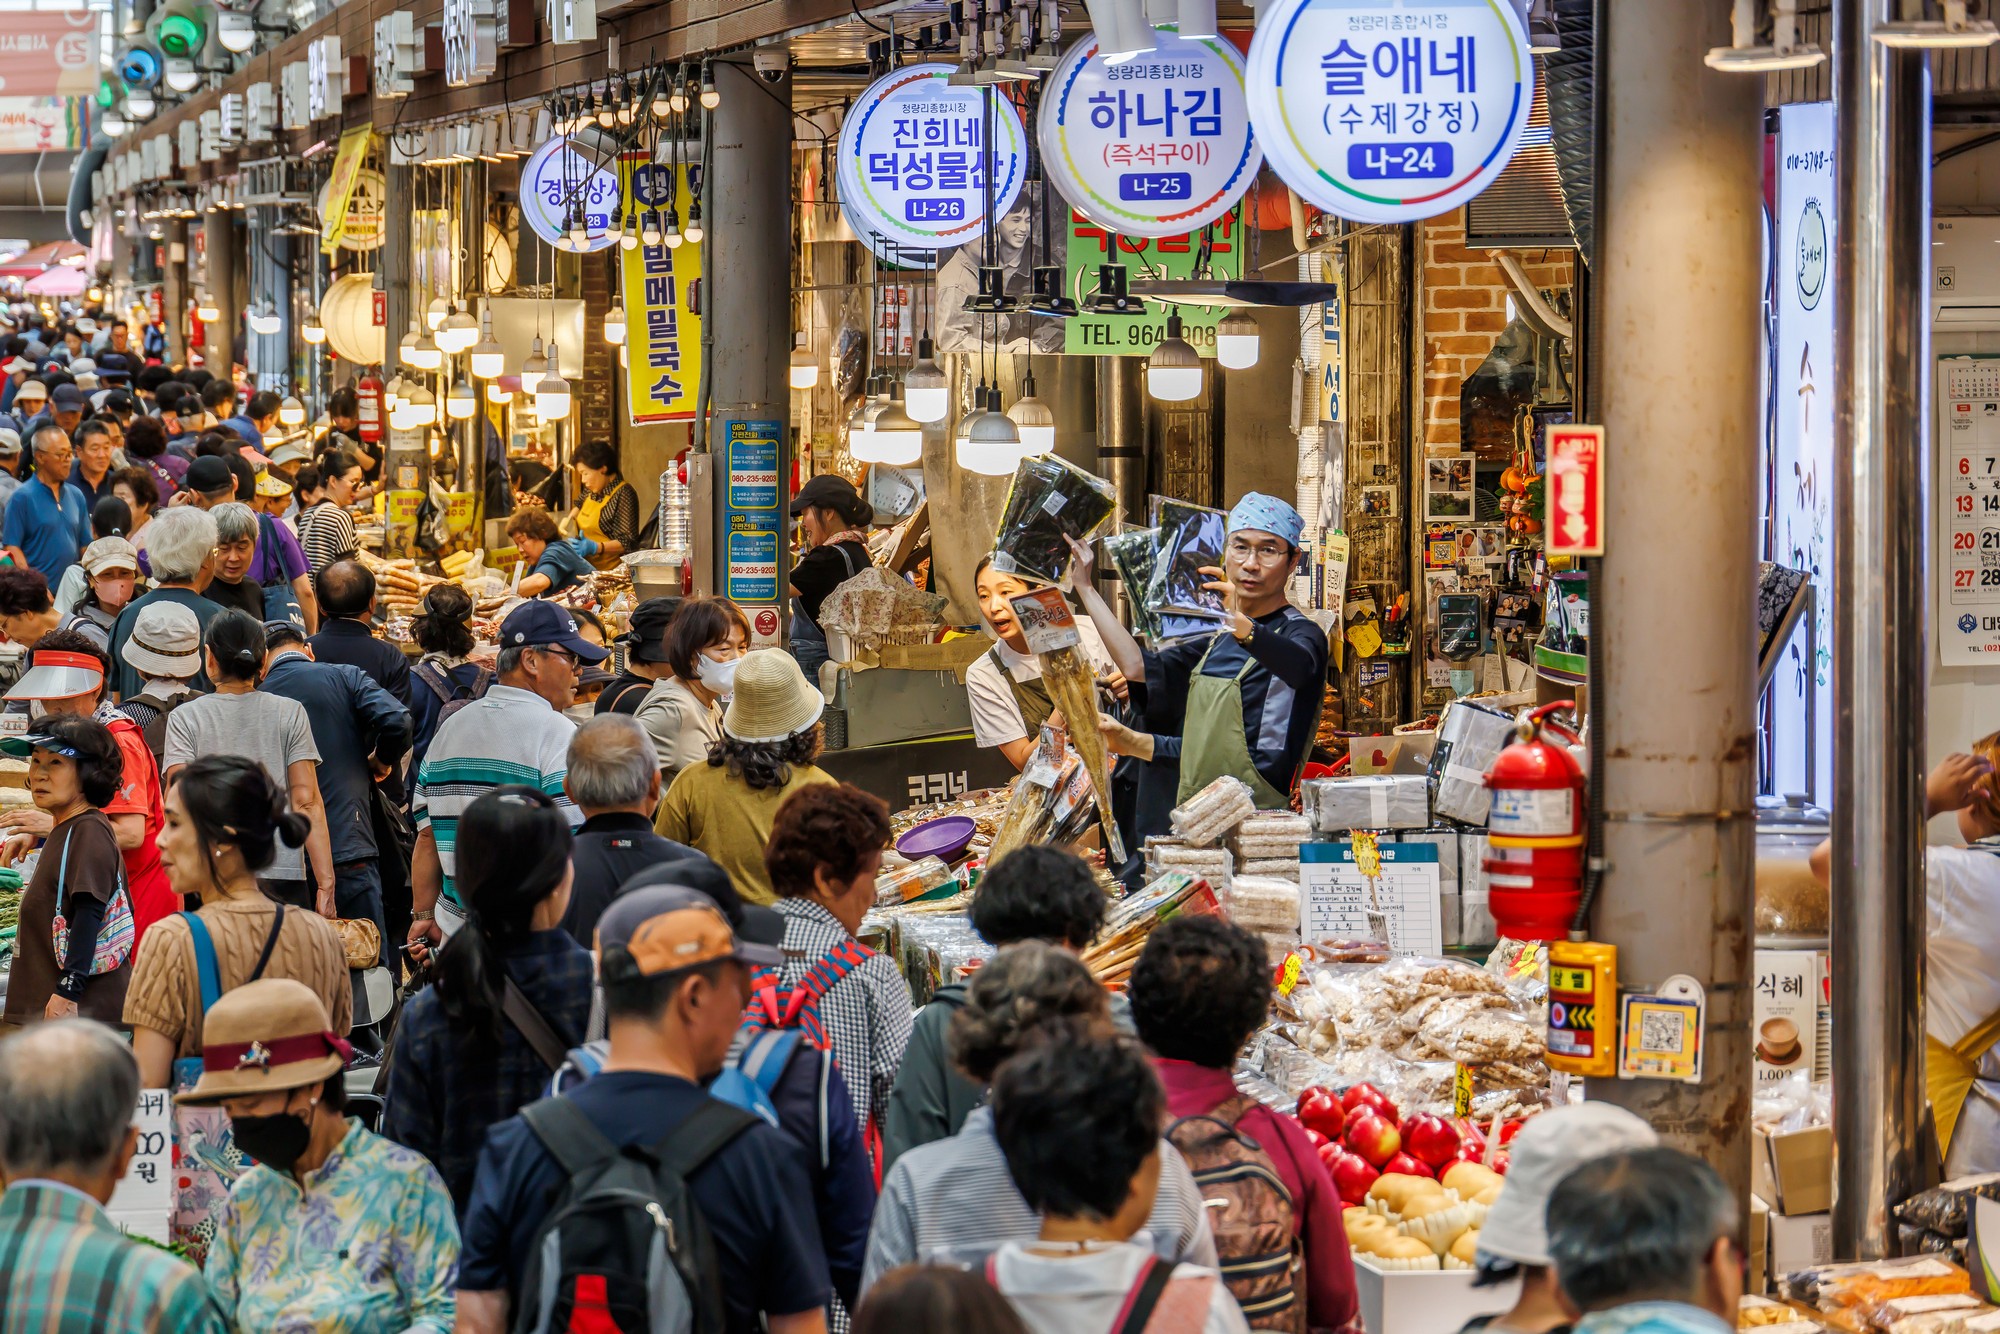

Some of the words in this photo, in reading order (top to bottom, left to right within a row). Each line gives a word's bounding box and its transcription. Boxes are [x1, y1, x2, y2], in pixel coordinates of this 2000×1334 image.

[1107, 63, 1205, 80] 청량리종합시장
[1321, 36, 1477, 96] 슬애네
[901, 102, 967, 114] 청량리종합시장
[1088, 87, 1223, 139] 하나김
[1322, 100, 1480, 135] (수제강정)
[893, 117, 980, 149] 진희네
[1103, 140, 1210, 168] (즉석구이)
[1364, 146, 1437, 176] 나-24
[868, 151, 1004, 192] 덕성물산
[639, 171, 669, 200] 냉
[1133, 177, 1182, 196] 나-25
[912, 201, 961, 218] 나-26
[1080, 323, 1121, 346] TEL.
[1958, 457, 1970, 475] 6
[1985, 457, 1996, 474] 7
[1955, 495, 1974, 512] 13
[1982, 494, 2000, 512] 14
[1953, 532, 1975, 549] 20
[1982, 531, 2000, 549] 21
[730, 566, 777, 575] 080-235-9203
[1954, 569, 1975, 587] 27
[1981, 568, 2000, 586] 28
[1982, 616, 2000, 631] 대
[1756, 972, 1803, 999] 식혜
[134, 1162, 158, 1184] 원
